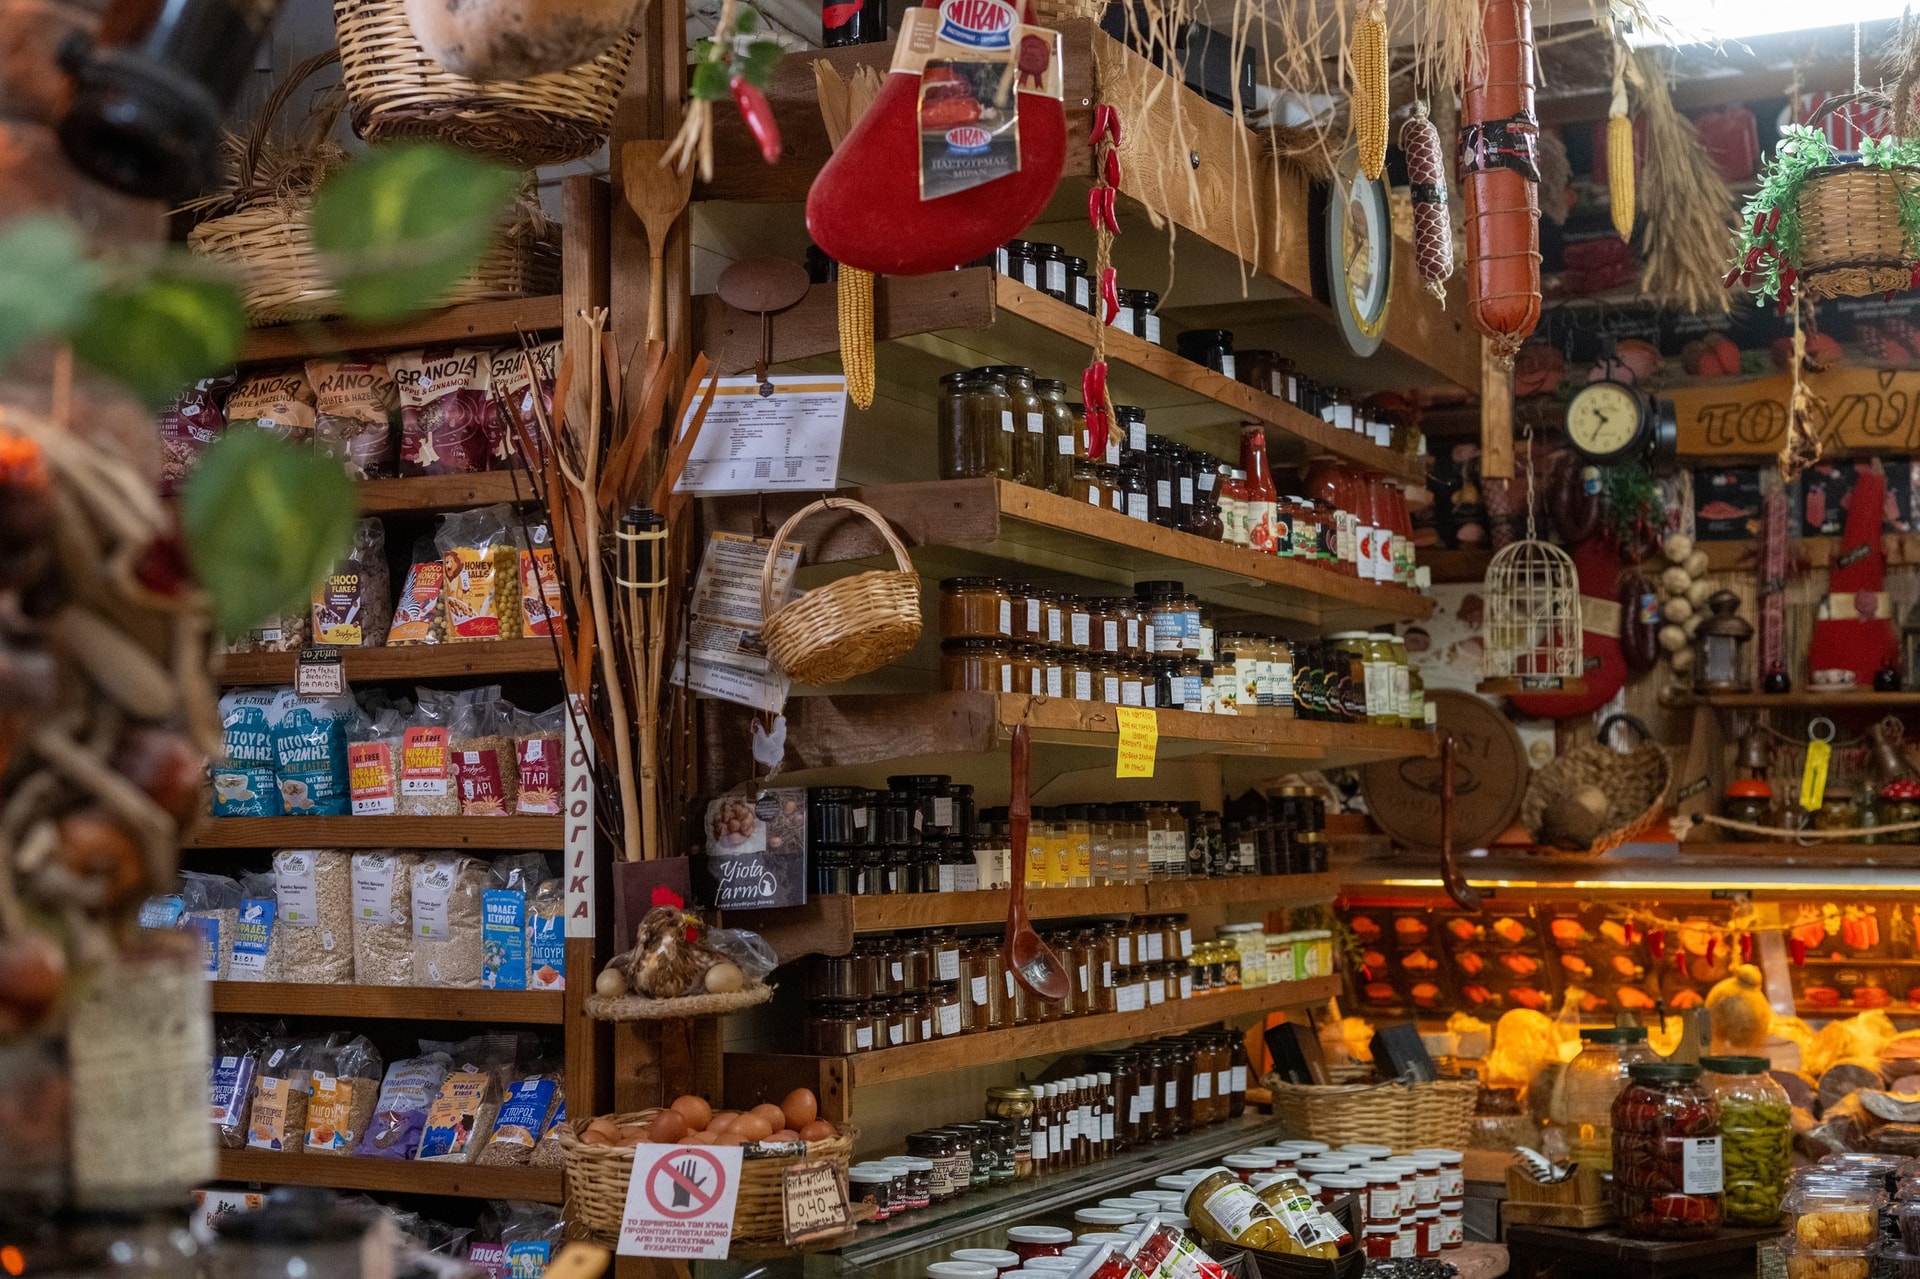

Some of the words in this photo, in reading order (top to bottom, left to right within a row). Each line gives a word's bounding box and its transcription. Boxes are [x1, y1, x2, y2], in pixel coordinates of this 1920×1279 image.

[946, 0, 1012, 31] MIRAN
[394, 355, 479, 386] GRANOLA
[319, 373, 395, 396] RANOLA
[399, 386, 422, 397] APPLE
[428, 378, 470, 394] CINNAMON
[421, 565, 442, 573] CHOCO
[464, 561, 493, 571] HONEY
[328, 574, 359, 586] CHOCO
[331, 585, 357, 594] FLAKES
[425, 734, 442, 742] FREE
[279, 744, 330, 766] ΒΡΩΜΗΣ
[364, 753, 380, 761] FREE
[406, 747, 444, 758] ΝΙΦΑΔΕΣ
[406, 756, 443, 768] ΒΡΩΜΗΣ
[351, 765, 388, 777] ΝΙΦΑΔΕΣ
[351, 775, 388, 788] ΒΡΩΜΗΣ
[719, 859, 764, 883] Yiota
[486, 903, 518, 915] ΝΙΦΑΔΕΣ
[487, 913, 516, 925] ΚΕΧΡΙΟΥ
[503, 1107, 536, 1118] ΣΠΟΡΟΣ
[930, 1173, 948, 1181] ΛΙΑΣ
[797, 1197, 827, 1219] 0,40
[687, 1221, 704, 1229] ΤΩΝ
[704, 1222, 729, 1230] ΧΥΜΑ
[665, 1237, 715, 1245] ΚΑΤΑΣΤΗΜΑ
[643, 1244, 705, 1254] ΕΥΧΑΡΙΣΤΟΥΜΕ
